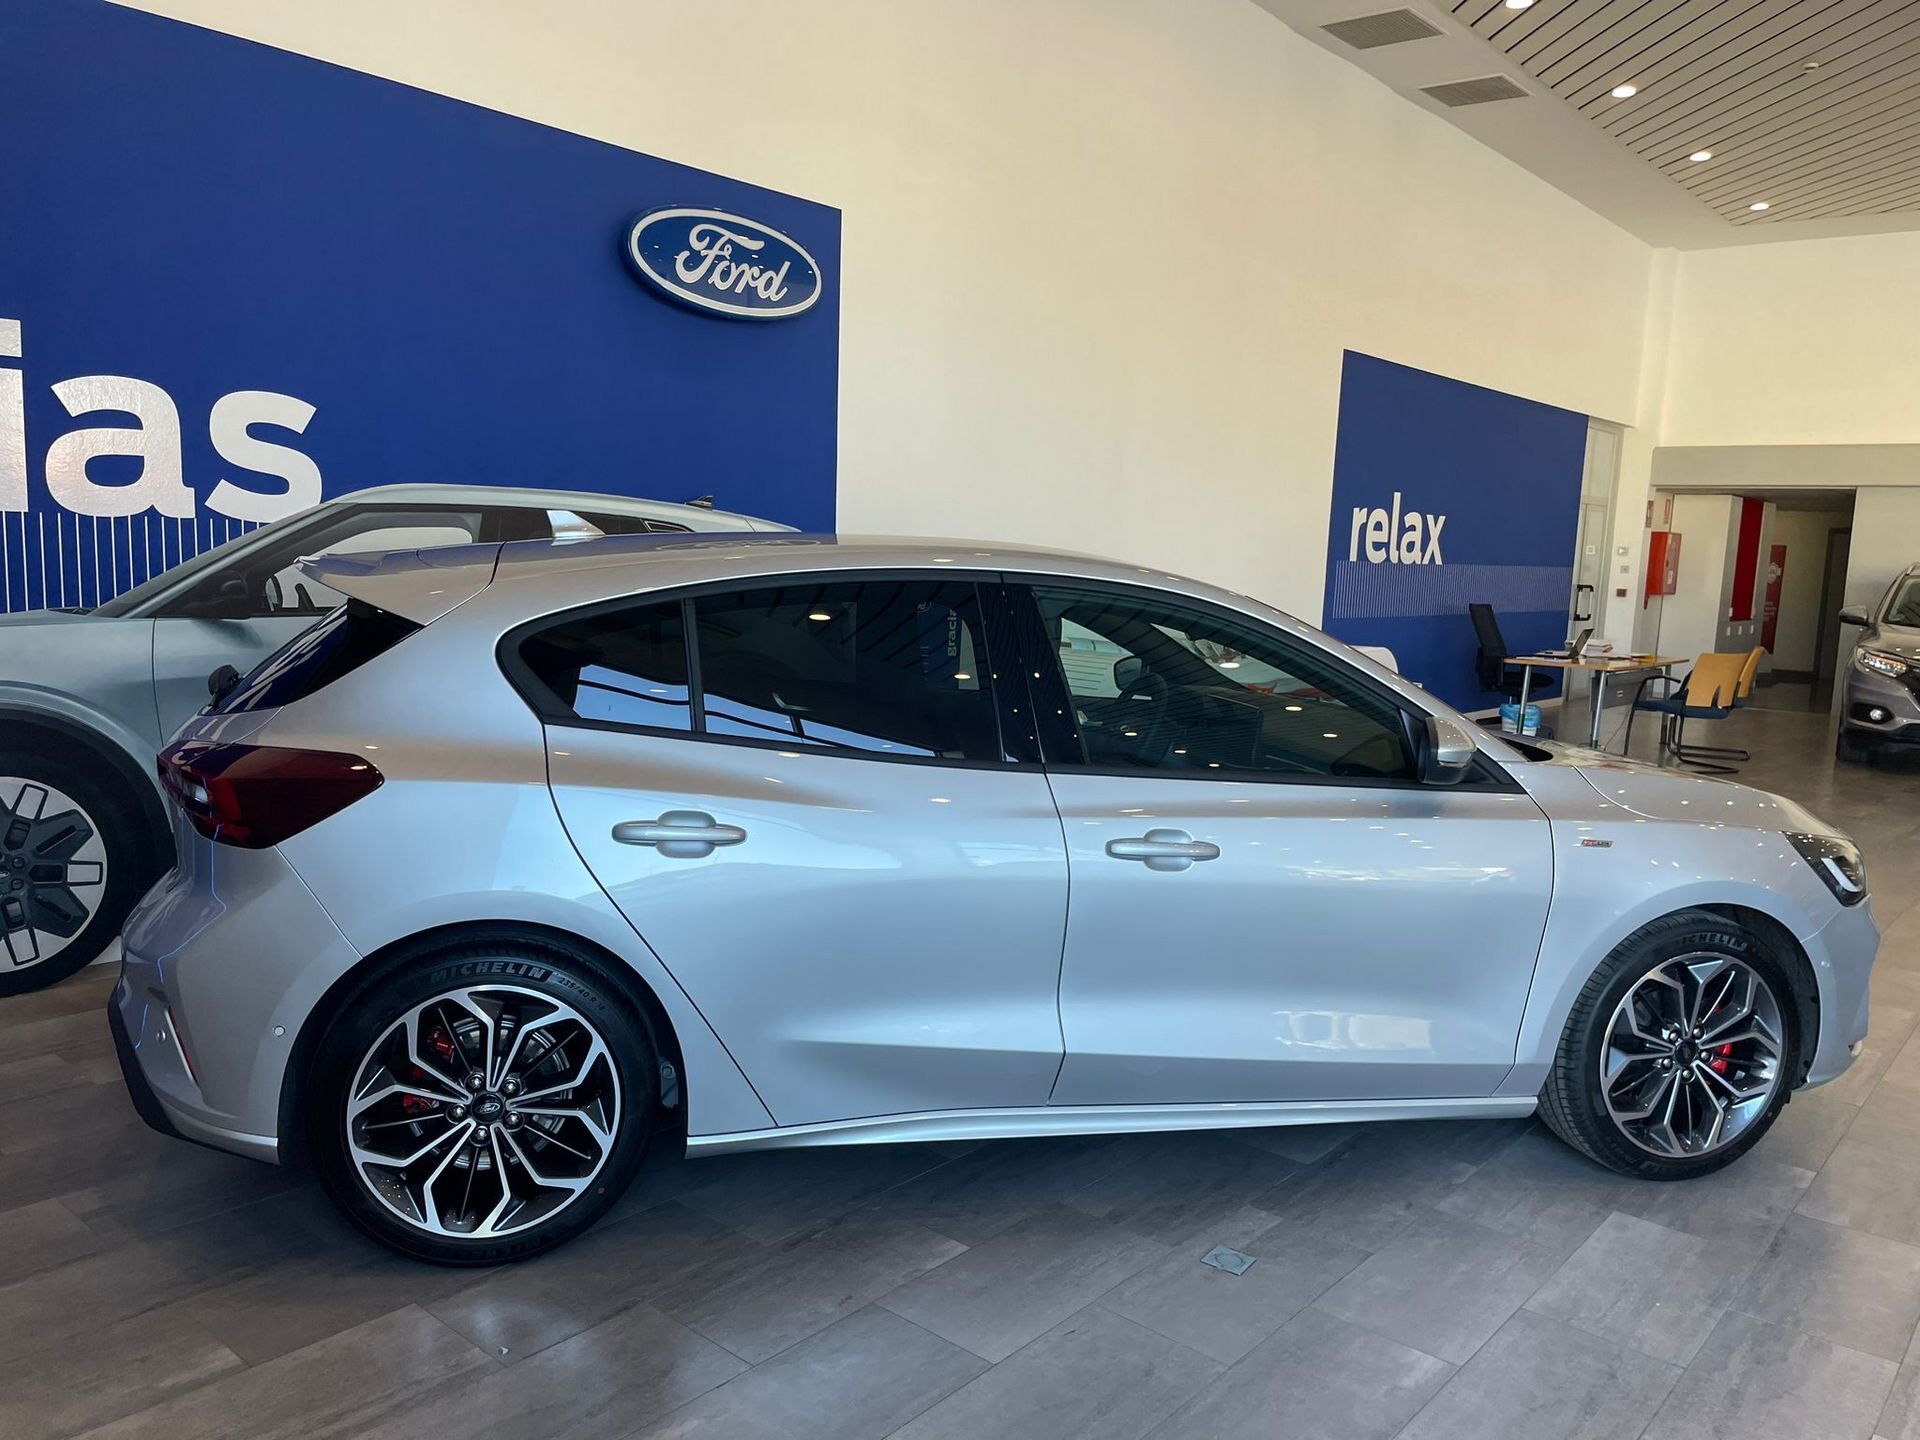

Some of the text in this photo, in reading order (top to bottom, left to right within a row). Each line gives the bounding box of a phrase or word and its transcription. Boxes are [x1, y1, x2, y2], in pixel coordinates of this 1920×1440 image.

[675, 223, 791, 302] Ford
[1349, 492, 1446, 566] relax
[1677, 932, 1748, 951] ICHELIN
[431, 961, 546, 983] MICHELIN
